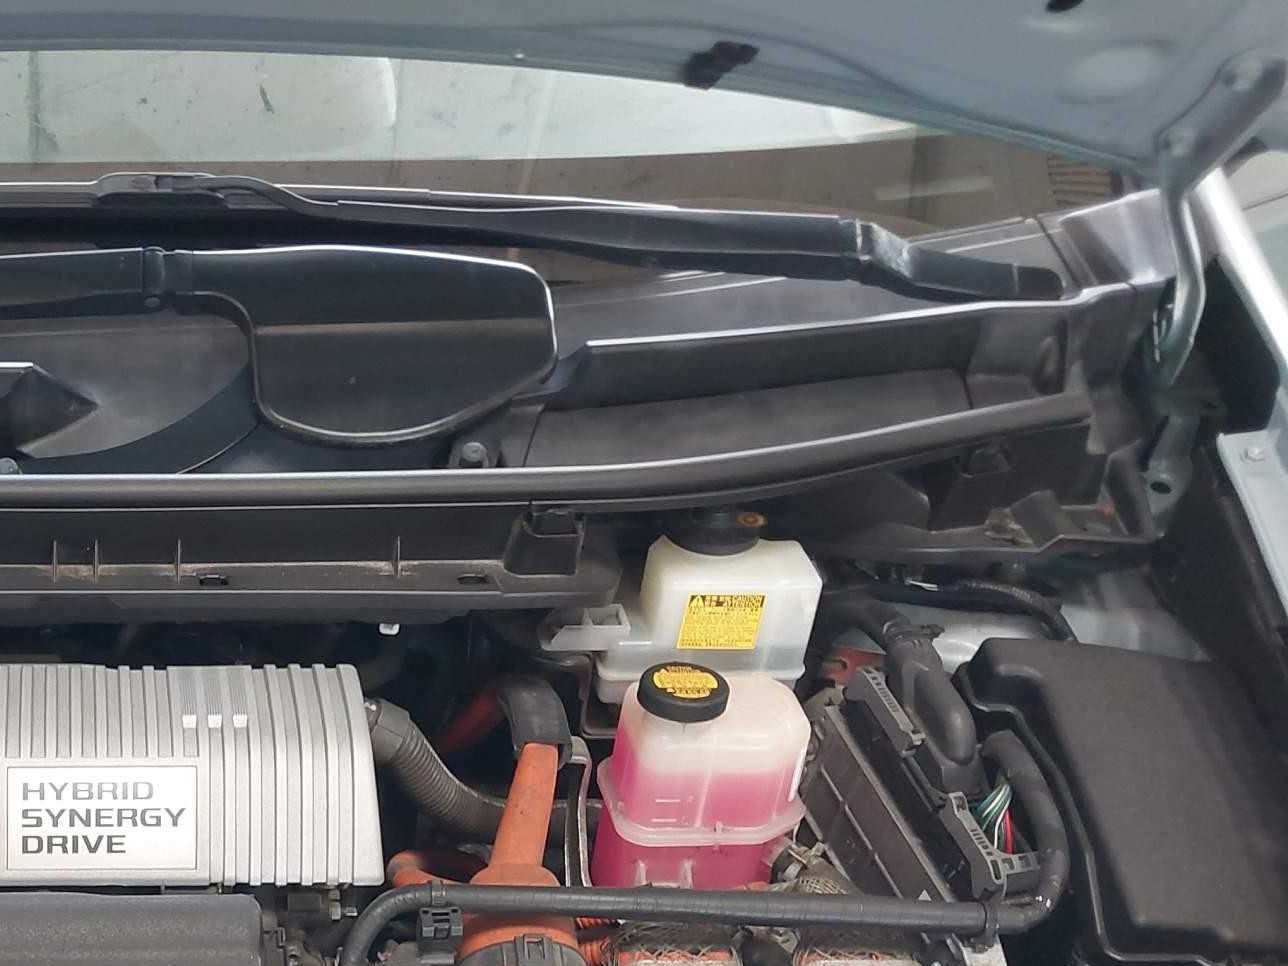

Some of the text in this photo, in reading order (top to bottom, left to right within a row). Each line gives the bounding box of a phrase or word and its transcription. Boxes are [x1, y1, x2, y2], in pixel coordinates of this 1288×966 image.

[22, 782, 154, 801] HYBRID
[21, 808, 186, 828] SYNERGY
[21, 835, 127, 854] DRIVE
